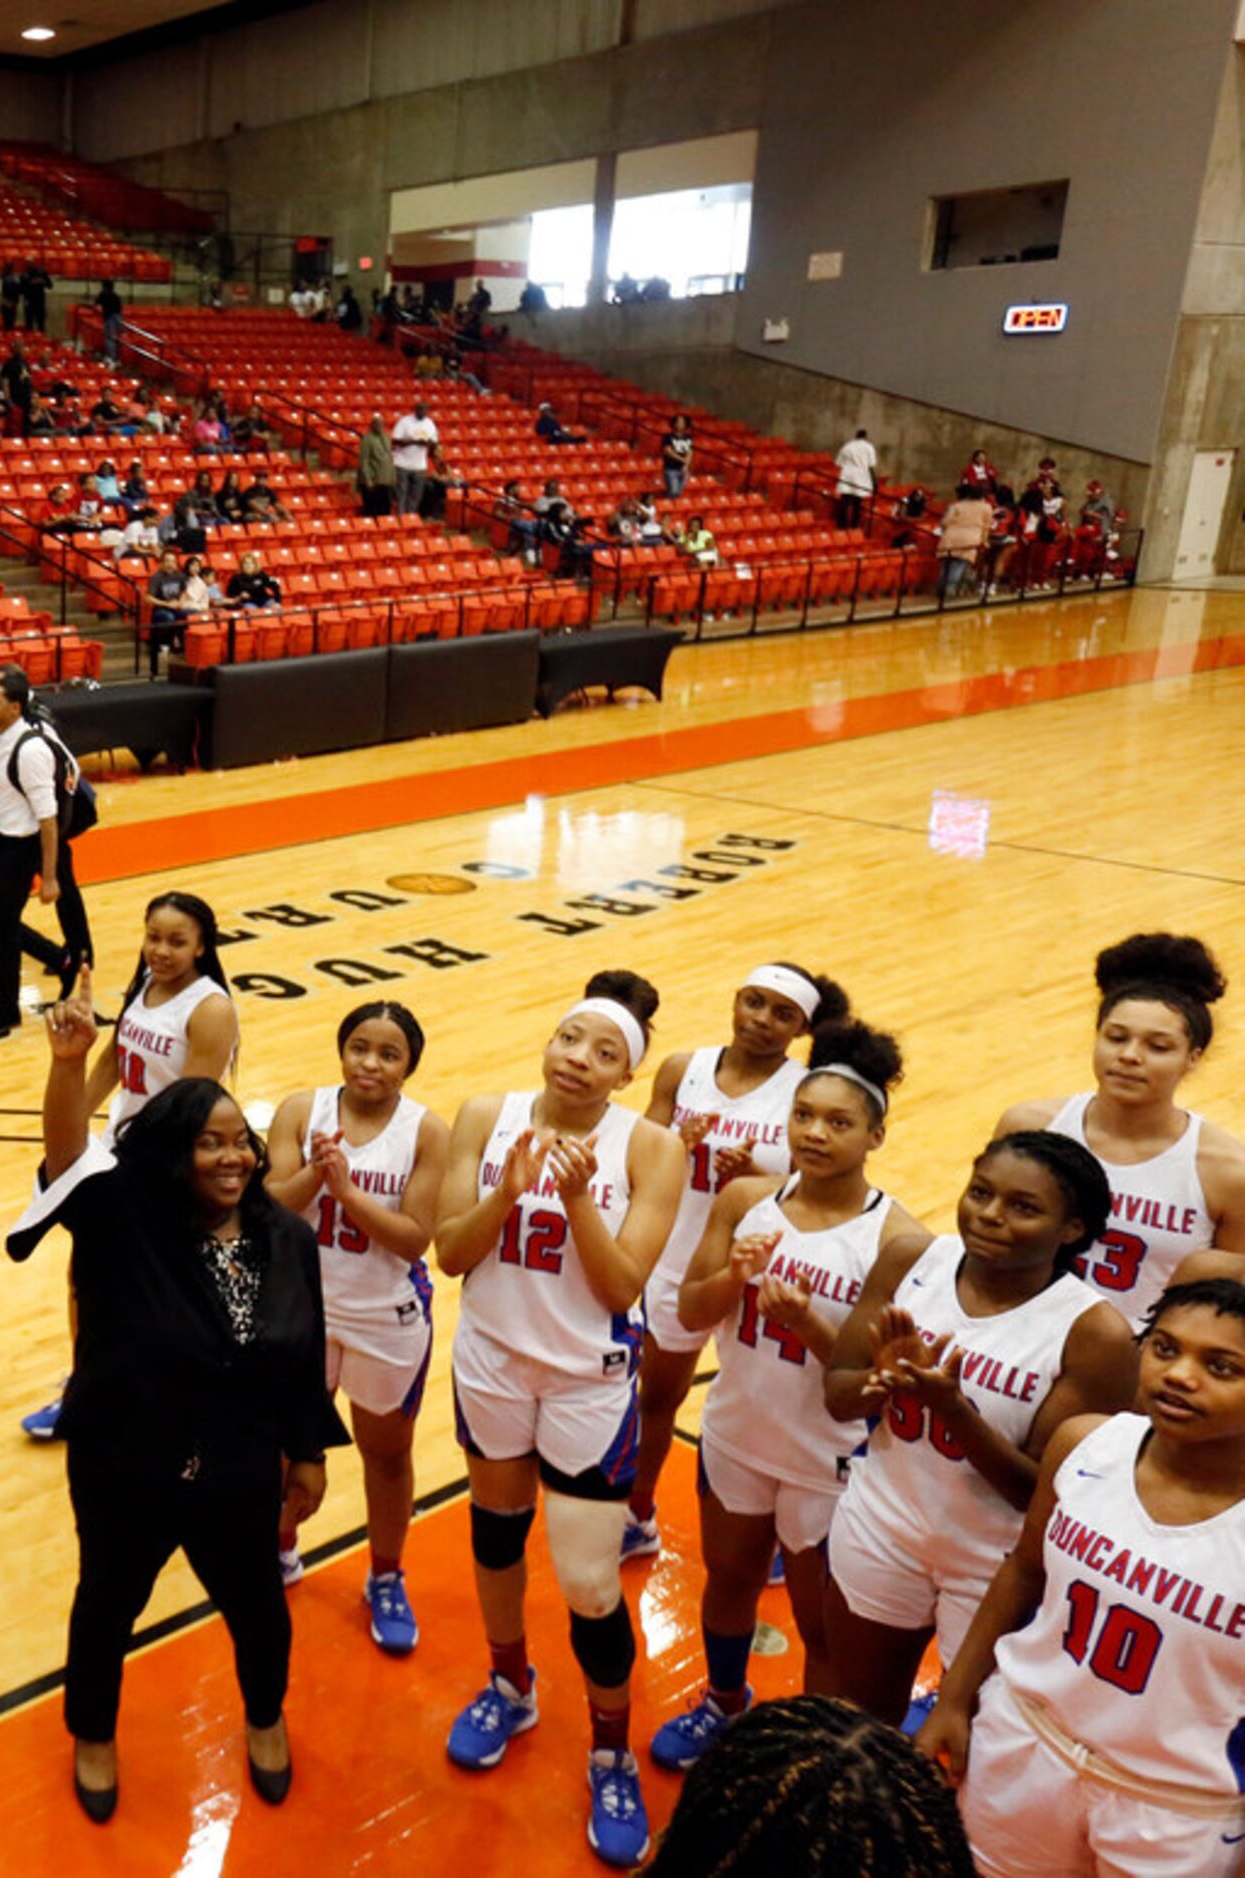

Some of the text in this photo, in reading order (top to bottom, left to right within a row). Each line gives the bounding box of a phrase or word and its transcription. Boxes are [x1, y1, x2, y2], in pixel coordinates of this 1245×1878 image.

[1010, 308, 1063, 328] OPEN
[229, 833, 797, 999] ROBERT HUG
[351, 1168, 406, 1196] NVILLE
[1110, 1191, 1197, 1235] NVILLE
[500, 1204, 568, 1275] 12
[1075, 1228, 1148, 1292] 3
[1048, 1509, 1245, 1640] DUNCANVILLE
[1062, 1579, 1163, 1696] 10
